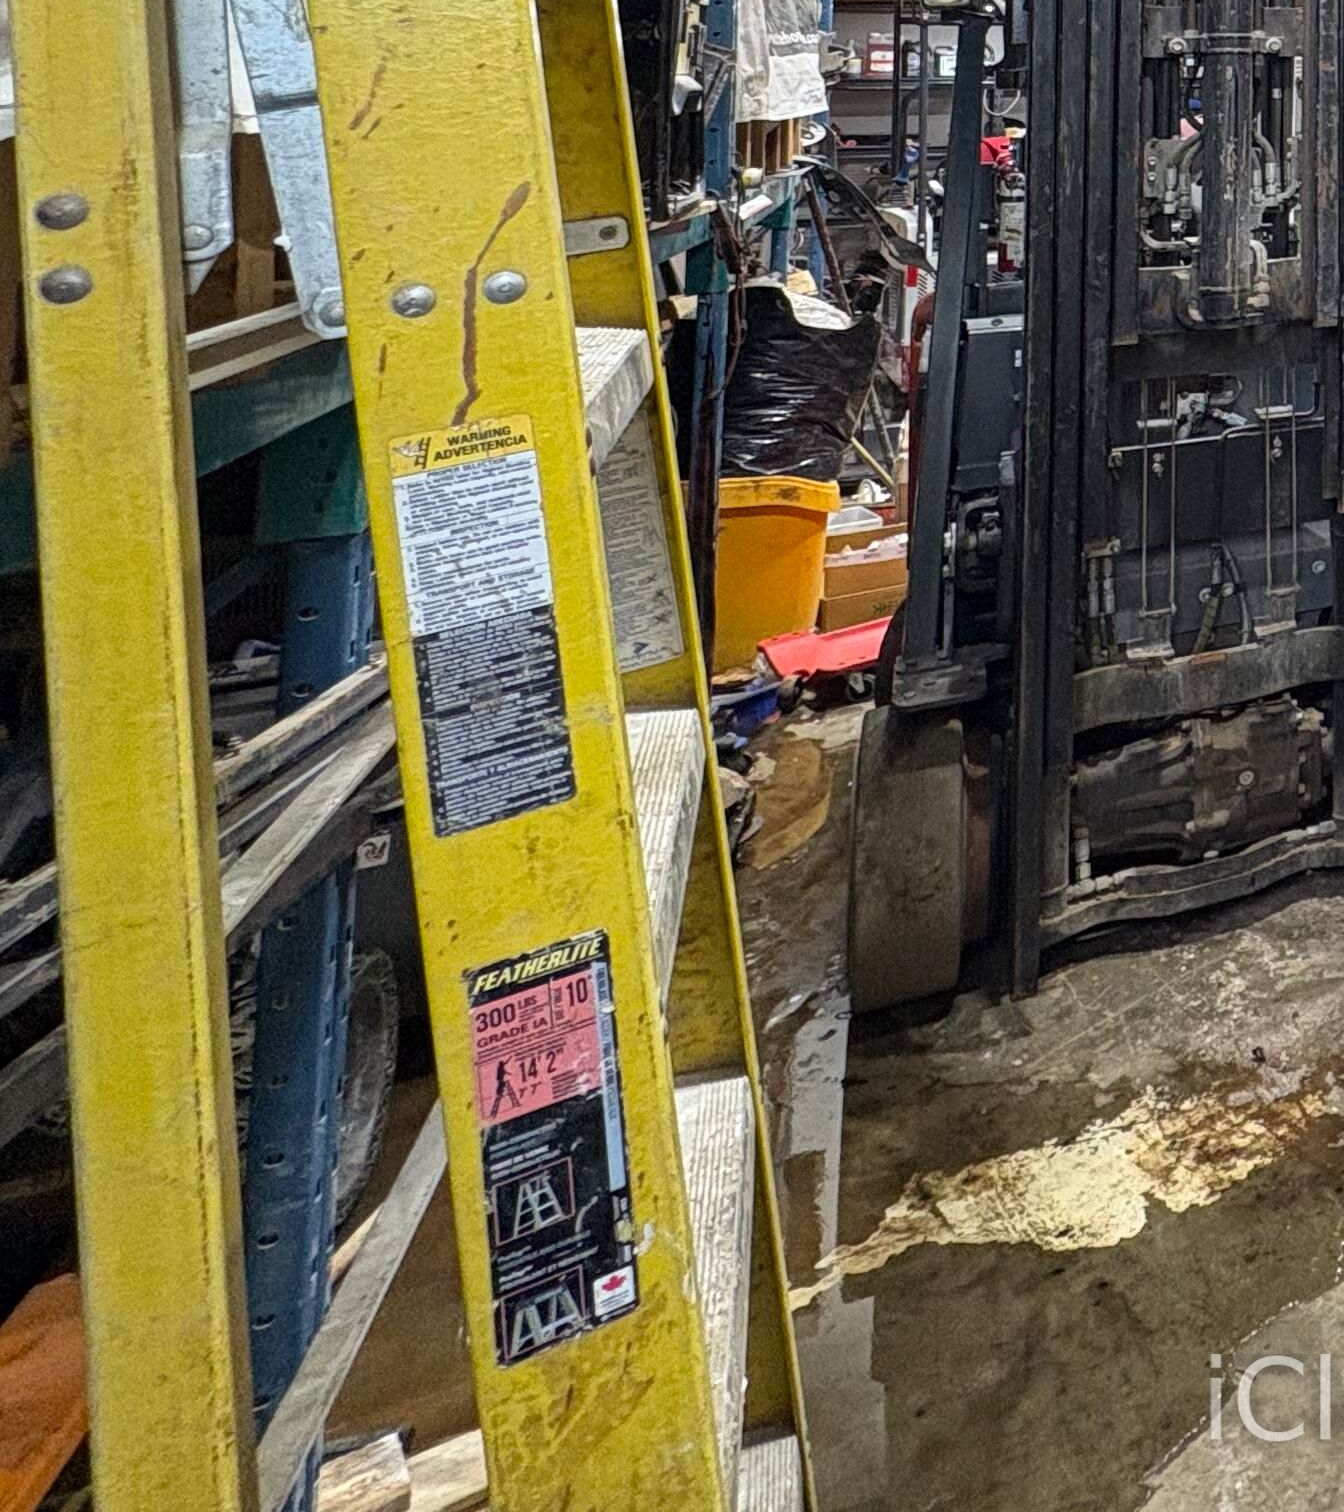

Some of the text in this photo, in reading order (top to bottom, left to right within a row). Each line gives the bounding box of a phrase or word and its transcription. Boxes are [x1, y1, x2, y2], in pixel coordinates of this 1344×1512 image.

[434, 434, 527, 461] ADVERTENCIA
[447, 425, 511, 446] WARNING
[471, 936, 604, 996] FEATHERLITE
[475, 1002, 517, 1033] 300
[477, 1022, 530, 1049] GRADE
